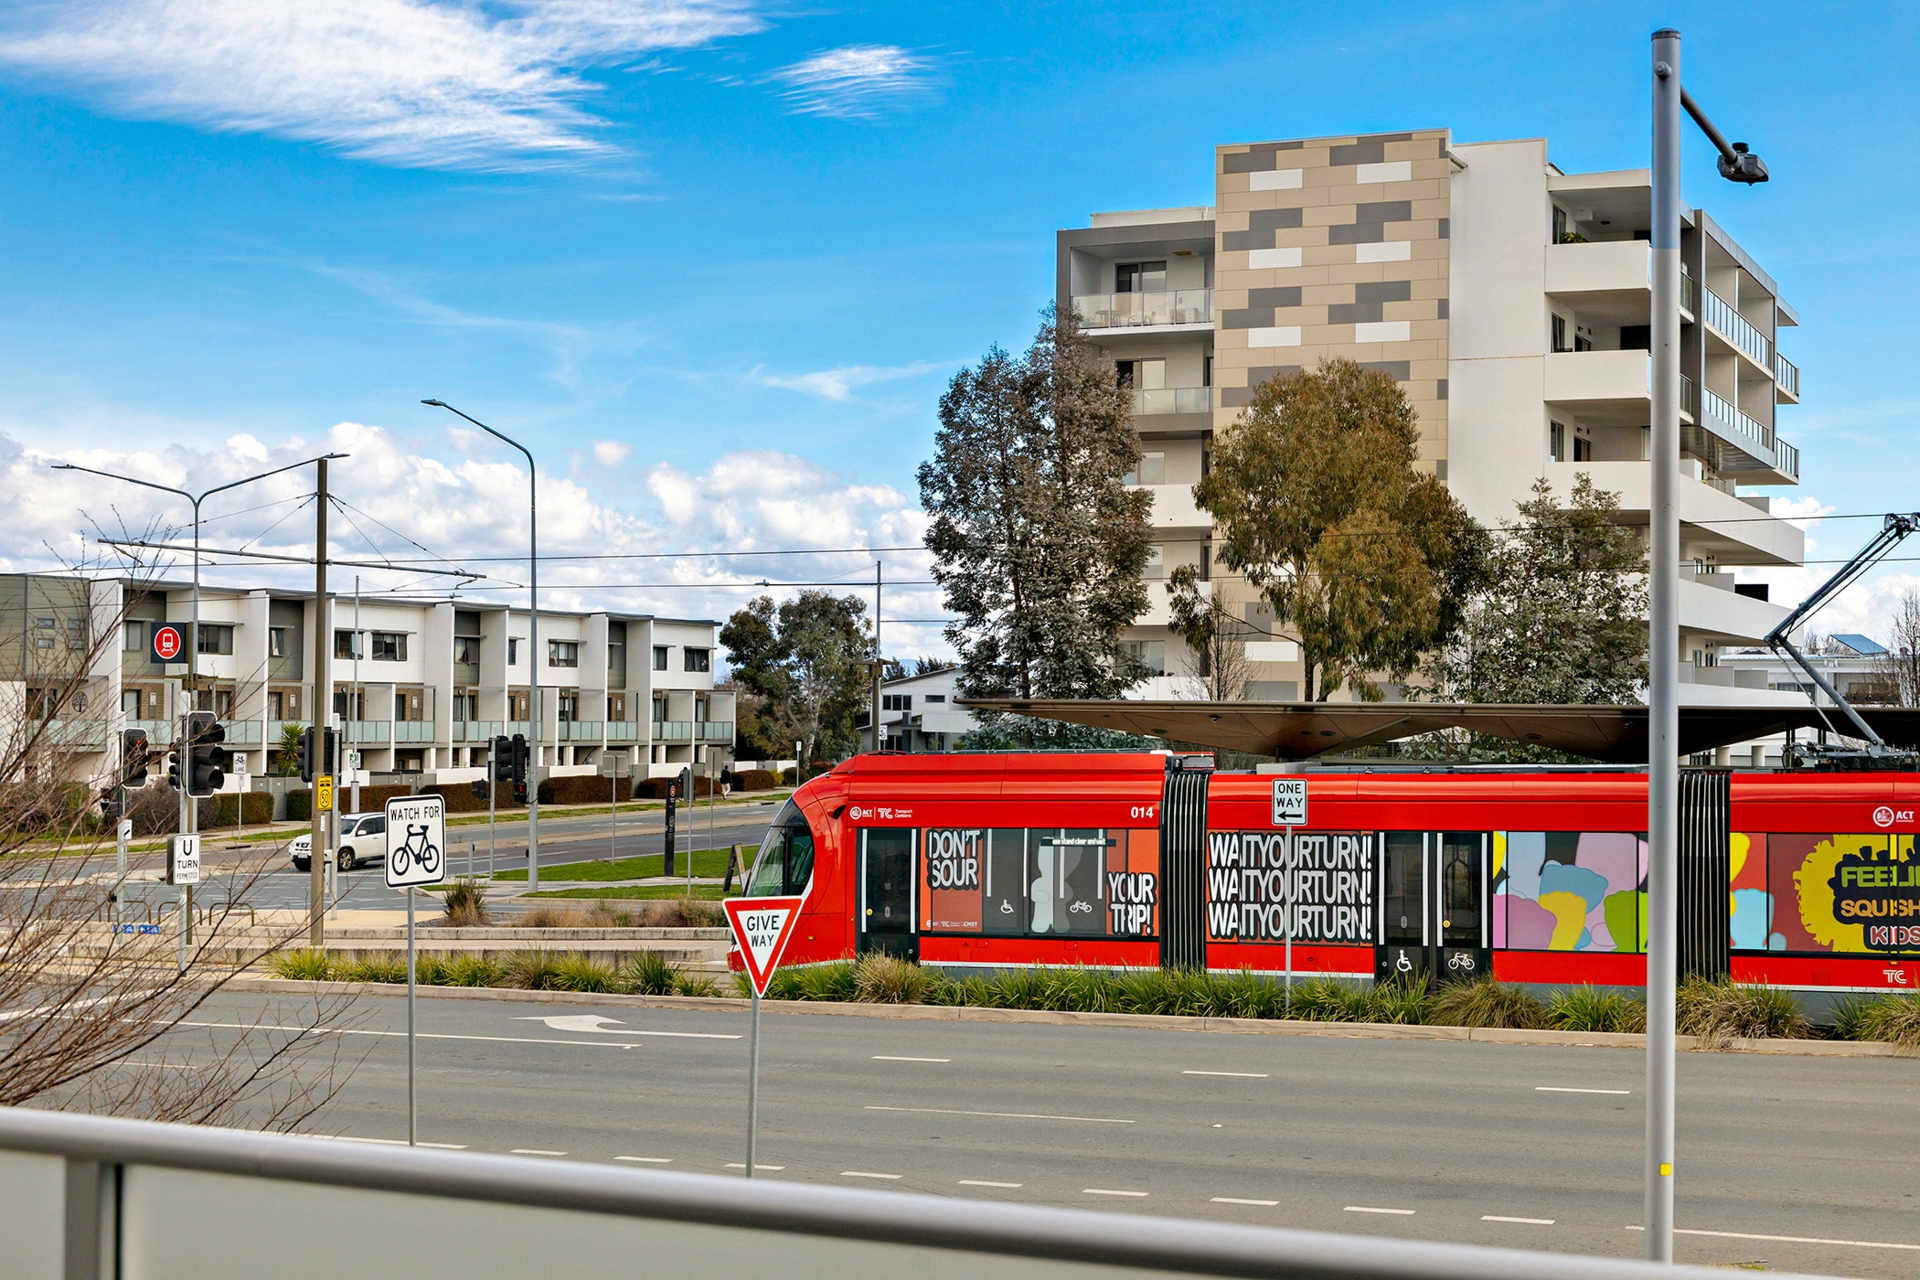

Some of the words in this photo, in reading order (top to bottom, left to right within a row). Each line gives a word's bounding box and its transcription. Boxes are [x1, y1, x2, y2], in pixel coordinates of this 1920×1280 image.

[1278, 783, 1302, 794] ONE
[1276, 797, 1303, 808] WAY
[390, 807, 420, 821] WATCH
[423, 805, 440, 819] FOR
[1130, 806, 1154, 819] 014
[1896, 811, 1914, 819] ACT
[183, 839, 193, 857] U
[929, 830, 981, 859] DON'T
[177, 859, 198, 869] TURN
[932, 858, 978, 888] SOUR
[1108, 872, 1154, 904] YOUR
[747, 915, 780, 931] GIVE
[1110, 903, 1151, 934] TRIP!
[751, 934, 774, 948] WAY
[1870, 925, 1920, 946] KIDS
[1883, 969, 1907, 984] TC
